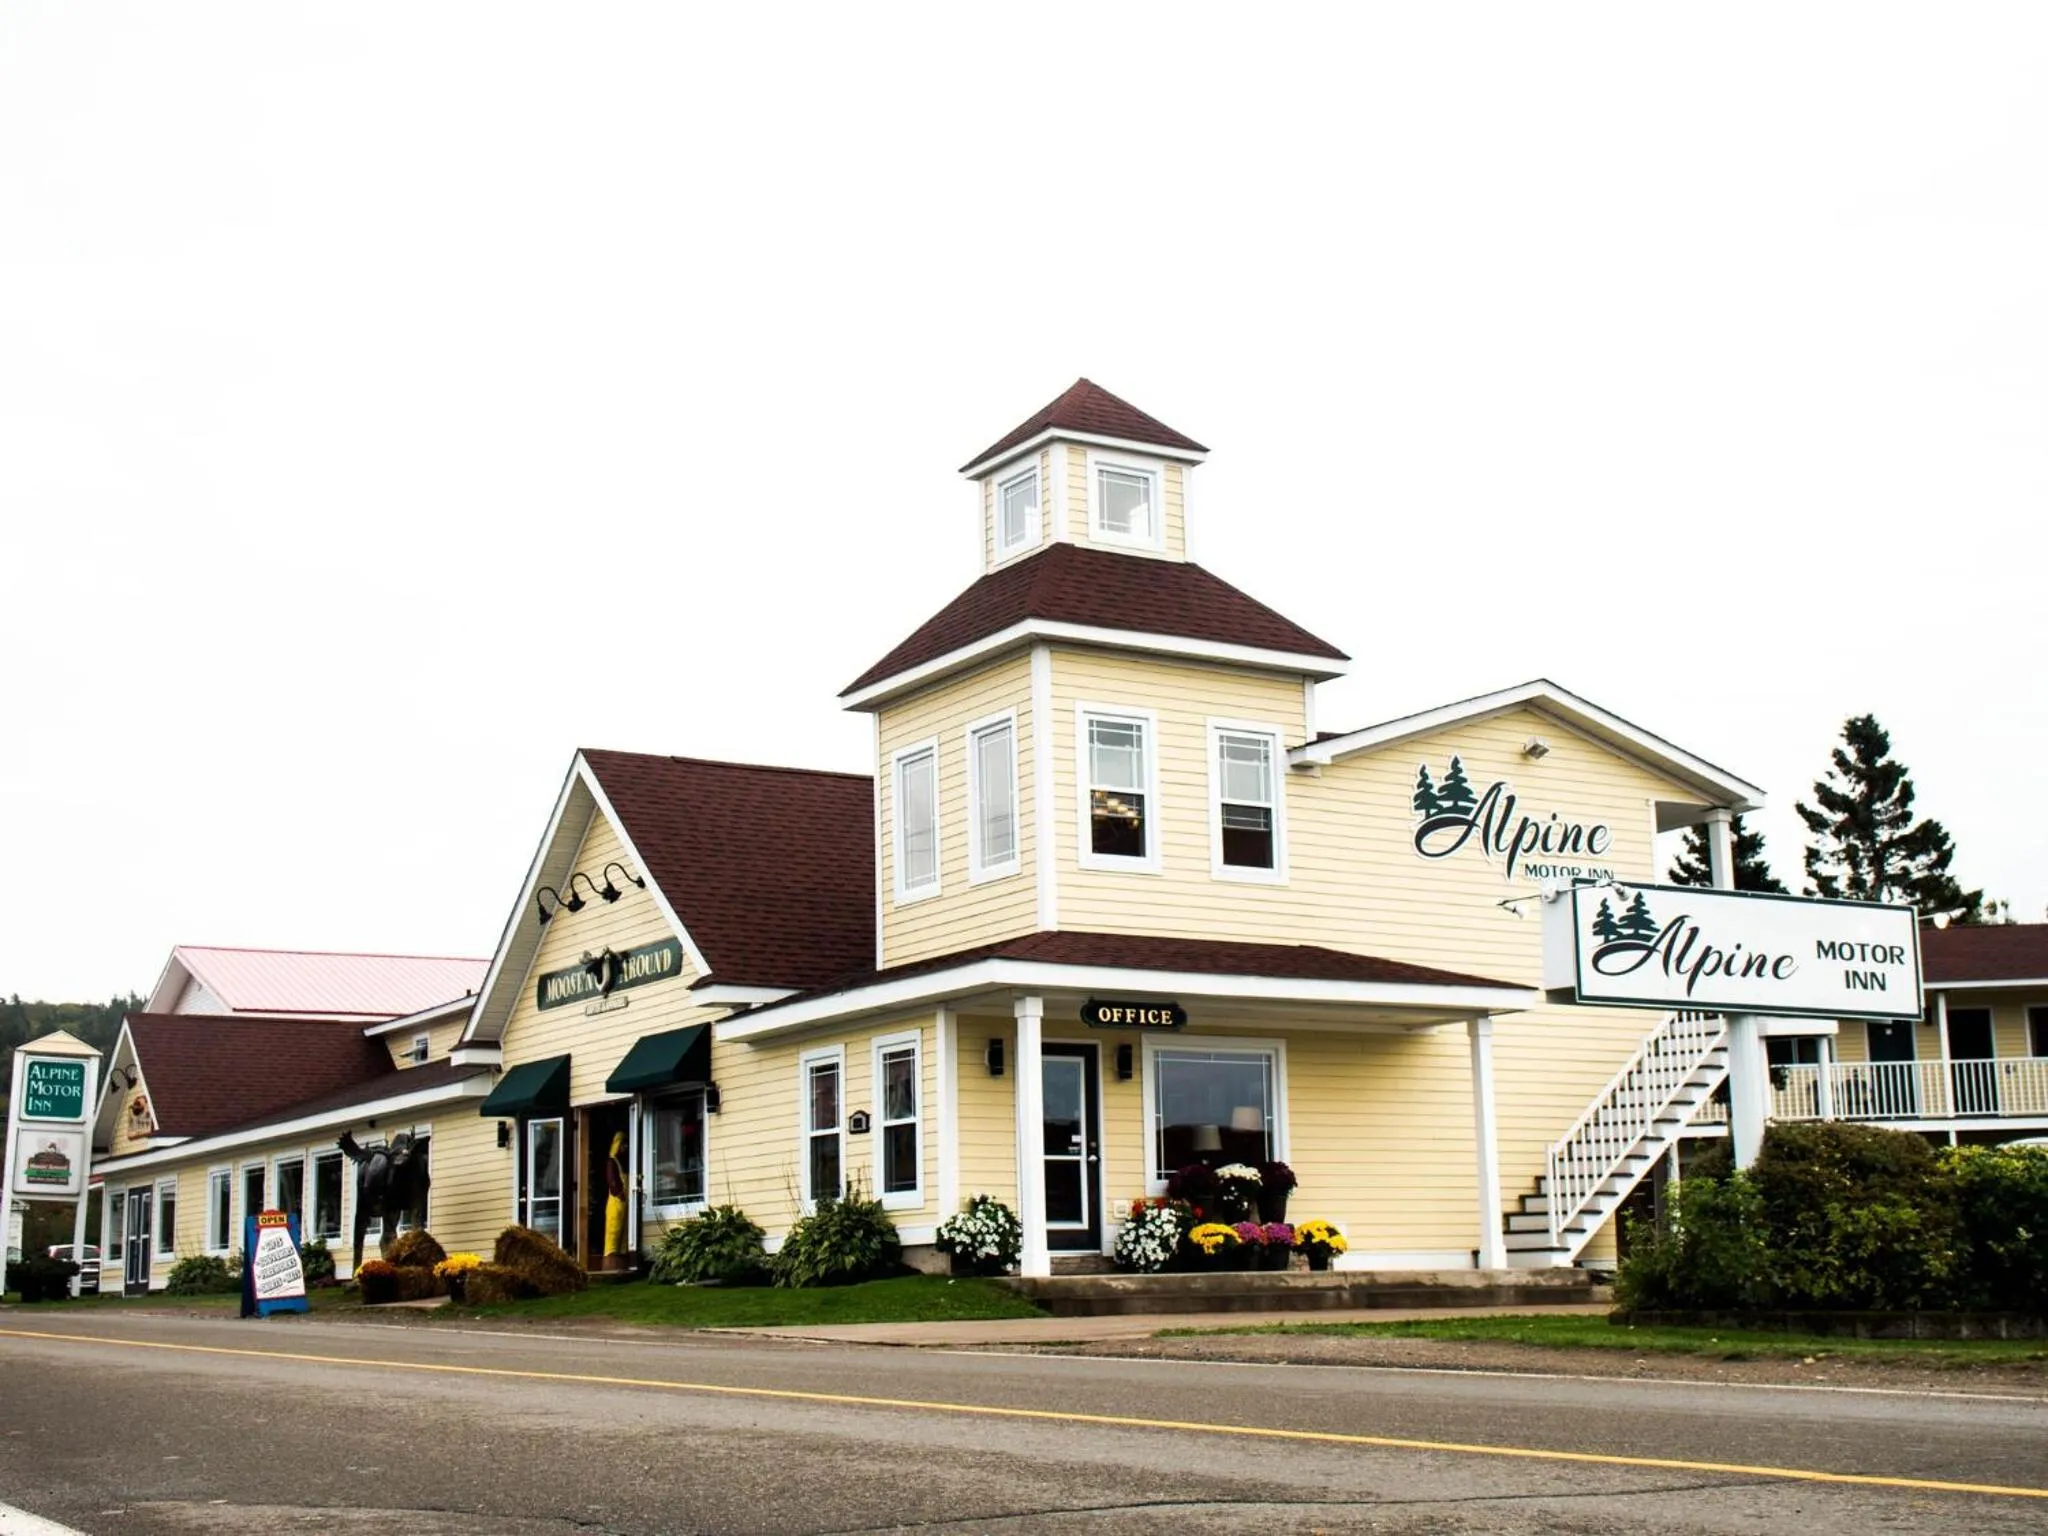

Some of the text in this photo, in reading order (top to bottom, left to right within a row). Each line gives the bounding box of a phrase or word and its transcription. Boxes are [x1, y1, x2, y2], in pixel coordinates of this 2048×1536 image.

[1414, 781, 1611, 880] Alpine
[1525, 863, 1615, 880] MOTOR INN
[1591, 914, 1799, 997] Alpine
[1816, 939, 1906, 966] MOTOR
[1845, 969, 1887, 992] INN
[1098, 1007, 1173, 1025] OFFICE
[260, 1215, 285, 1225] OPEN
